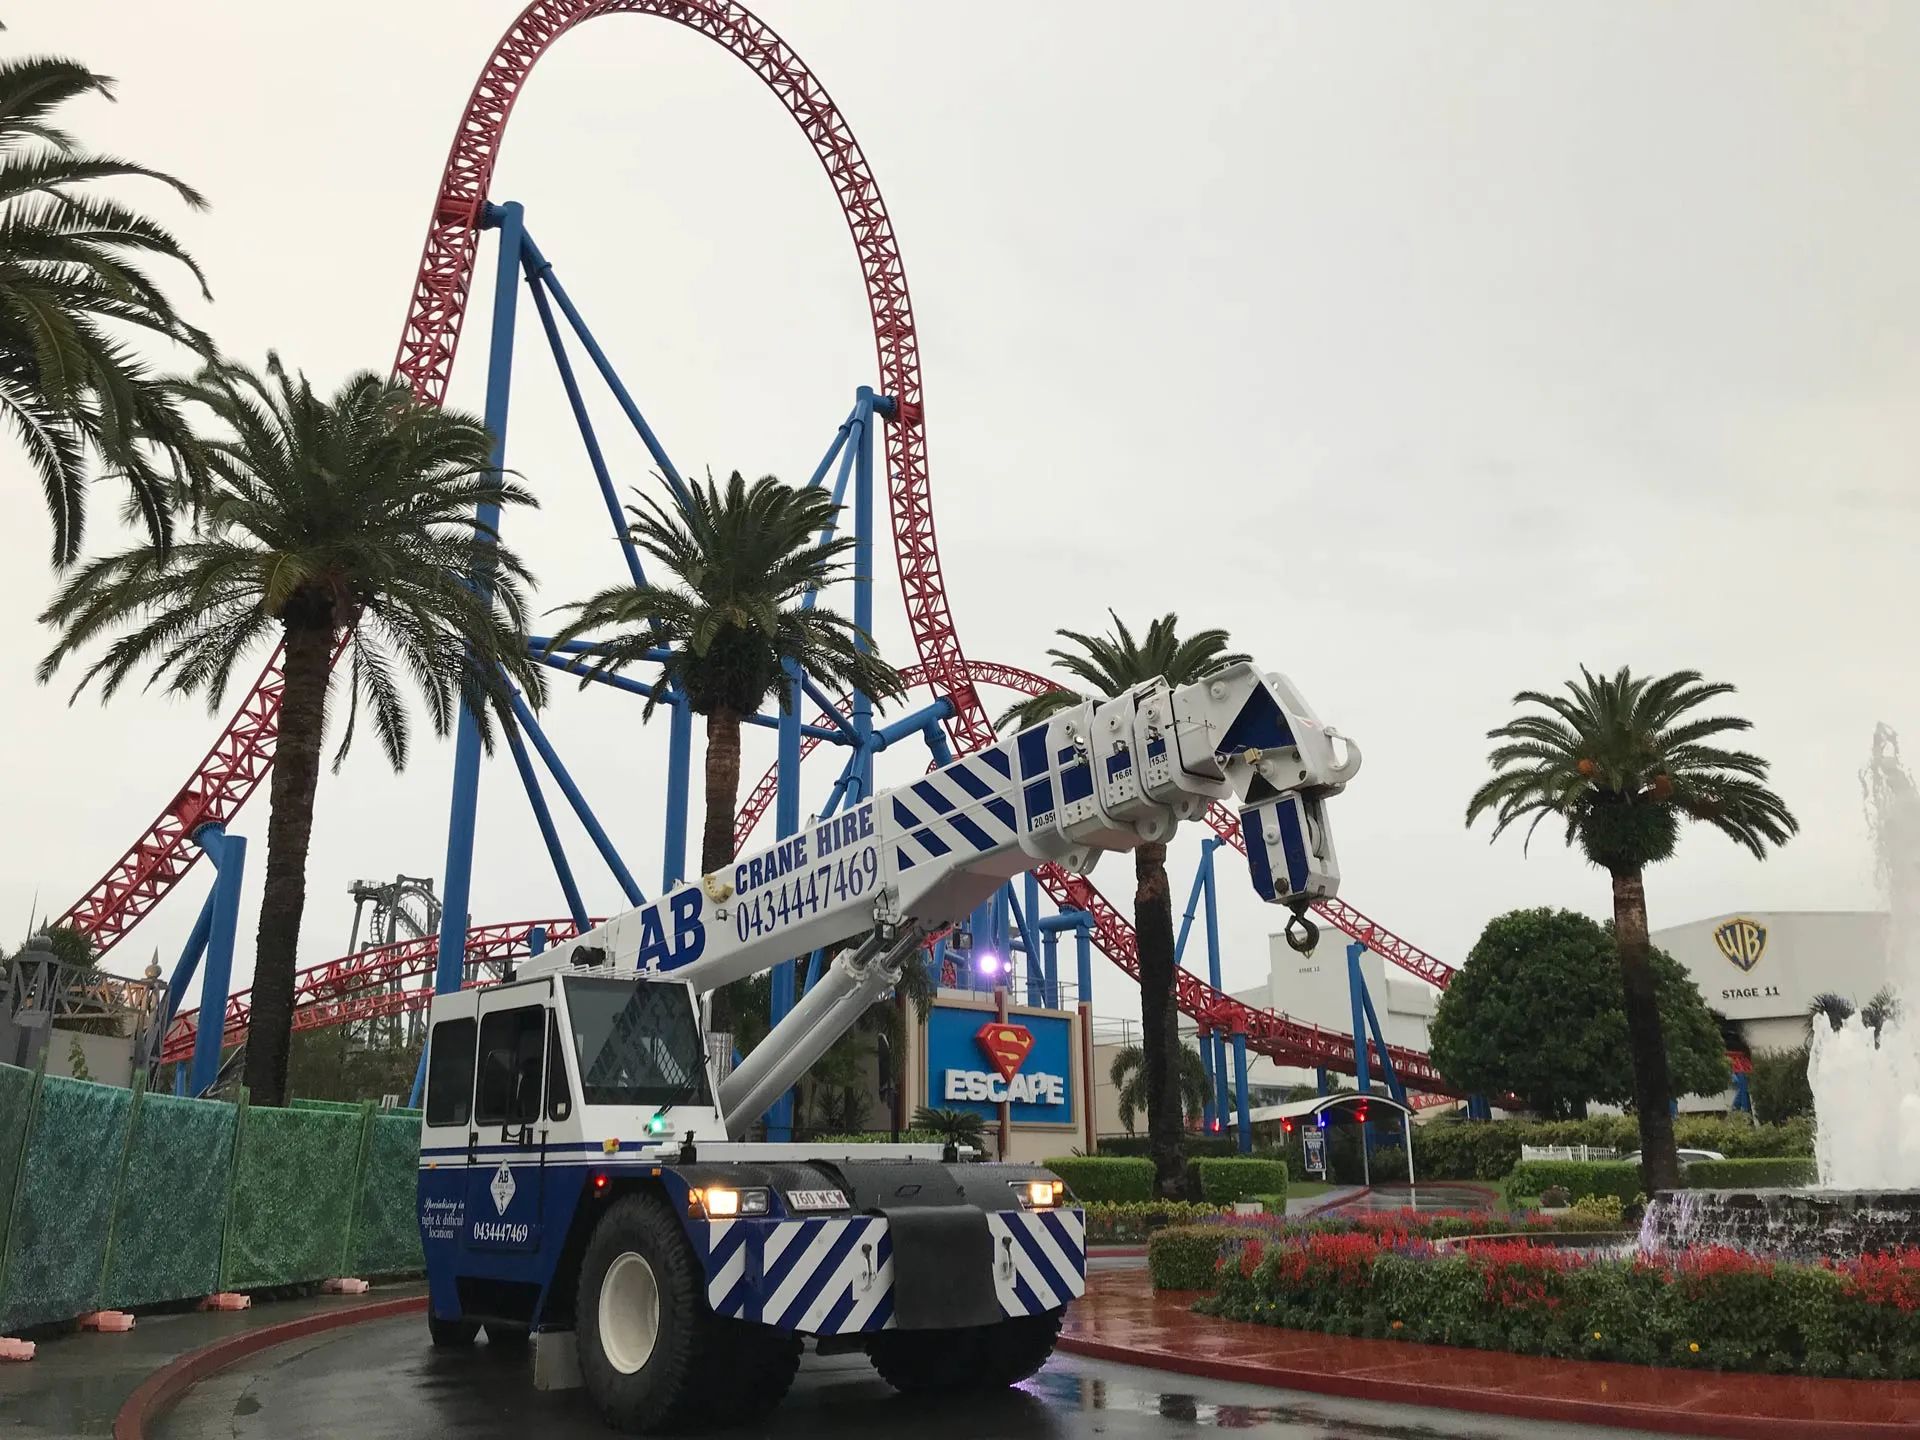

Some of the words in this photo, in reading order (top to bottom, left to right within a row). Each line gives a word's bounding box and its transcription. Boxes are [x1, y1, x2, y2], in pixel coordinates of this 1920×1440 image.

[1114, 768, 1133, 781] 16.6t
[1034, 811, 1056, 829] 20.95t
[735, 835, 808, 896] CRANE
[816, 803, 874, 859] HIRE
[736, 846, 878, 943] 0434447469
[636, 887, 706, 973] AB
[1718, 922, 1761, 967] WB
[1722, 988, 1759, 999] STAGE
[1765, 986, 1780, 997] 11
[945, 1068, 1065, 1105] ESCAPE
[498, 1170, 509, 1183] AB
[473, 1222, 528, 1242] 0434447469
